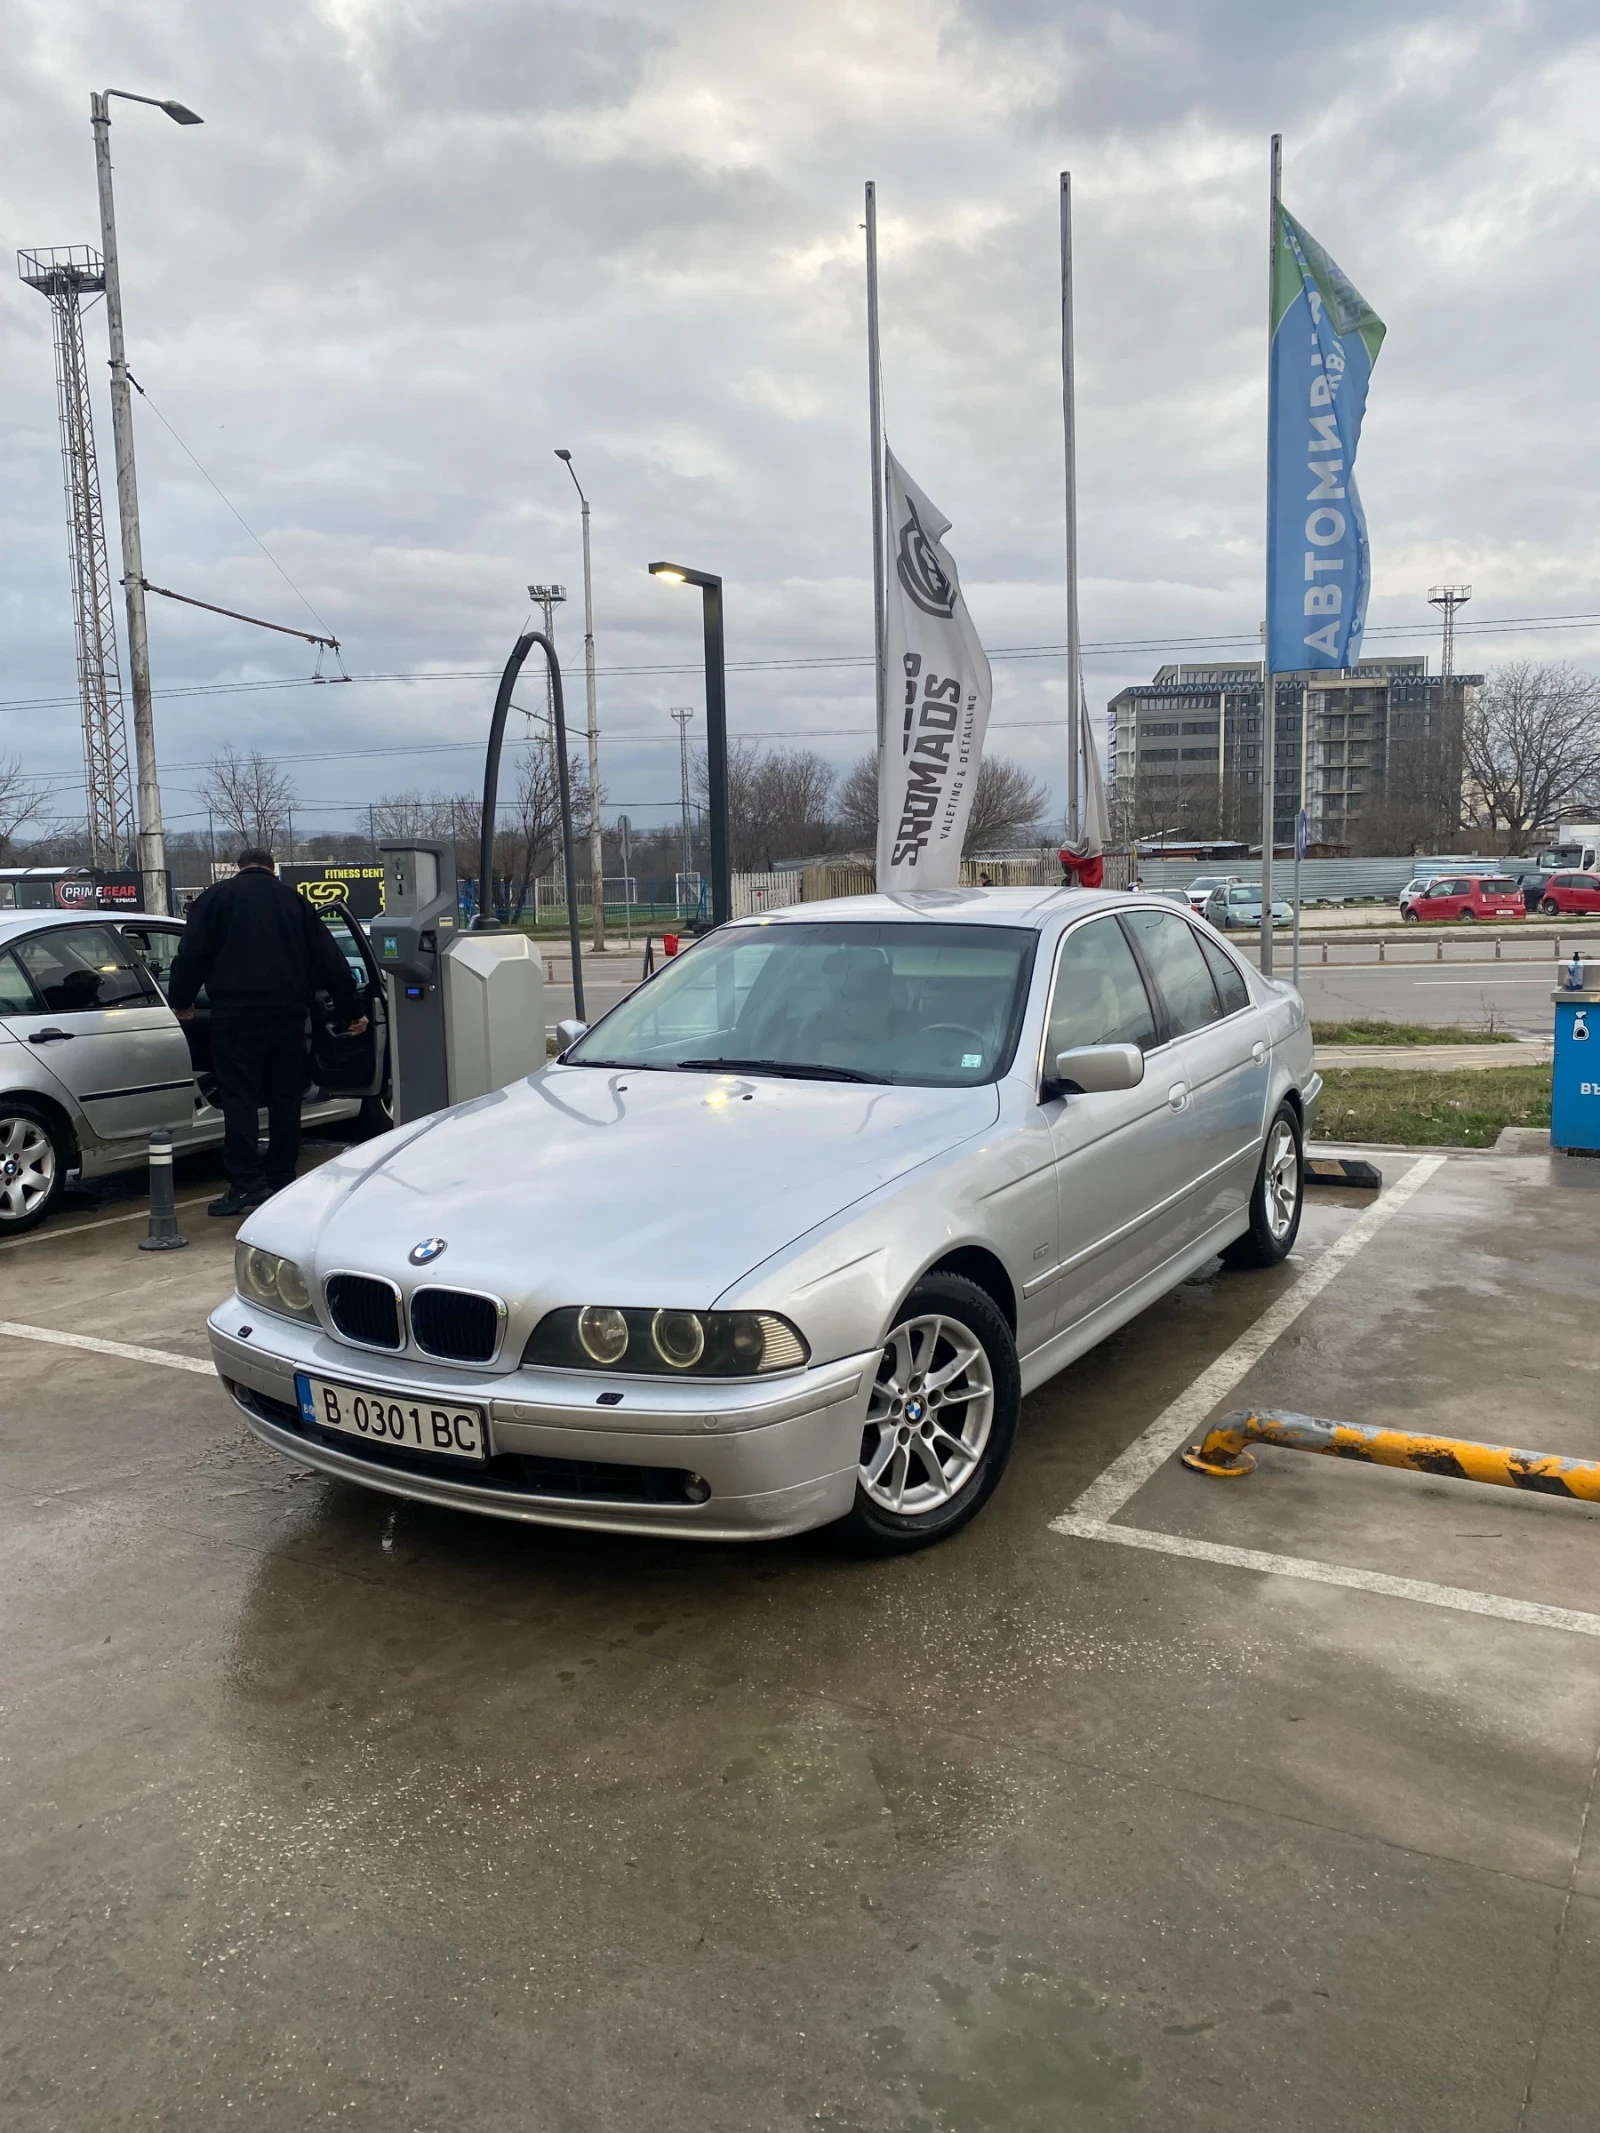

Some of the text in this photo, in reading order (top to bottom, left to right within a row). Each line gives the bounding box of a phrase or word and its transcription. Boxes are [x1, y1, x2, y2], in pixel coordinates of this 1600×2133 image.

[940, 782, 963, 840] VALETING
[960, 695, 977, 763] DETAILING
[324, 868, 361, 879] FITNESS
[322, 1387, 476, 1451] B 0301 BC
